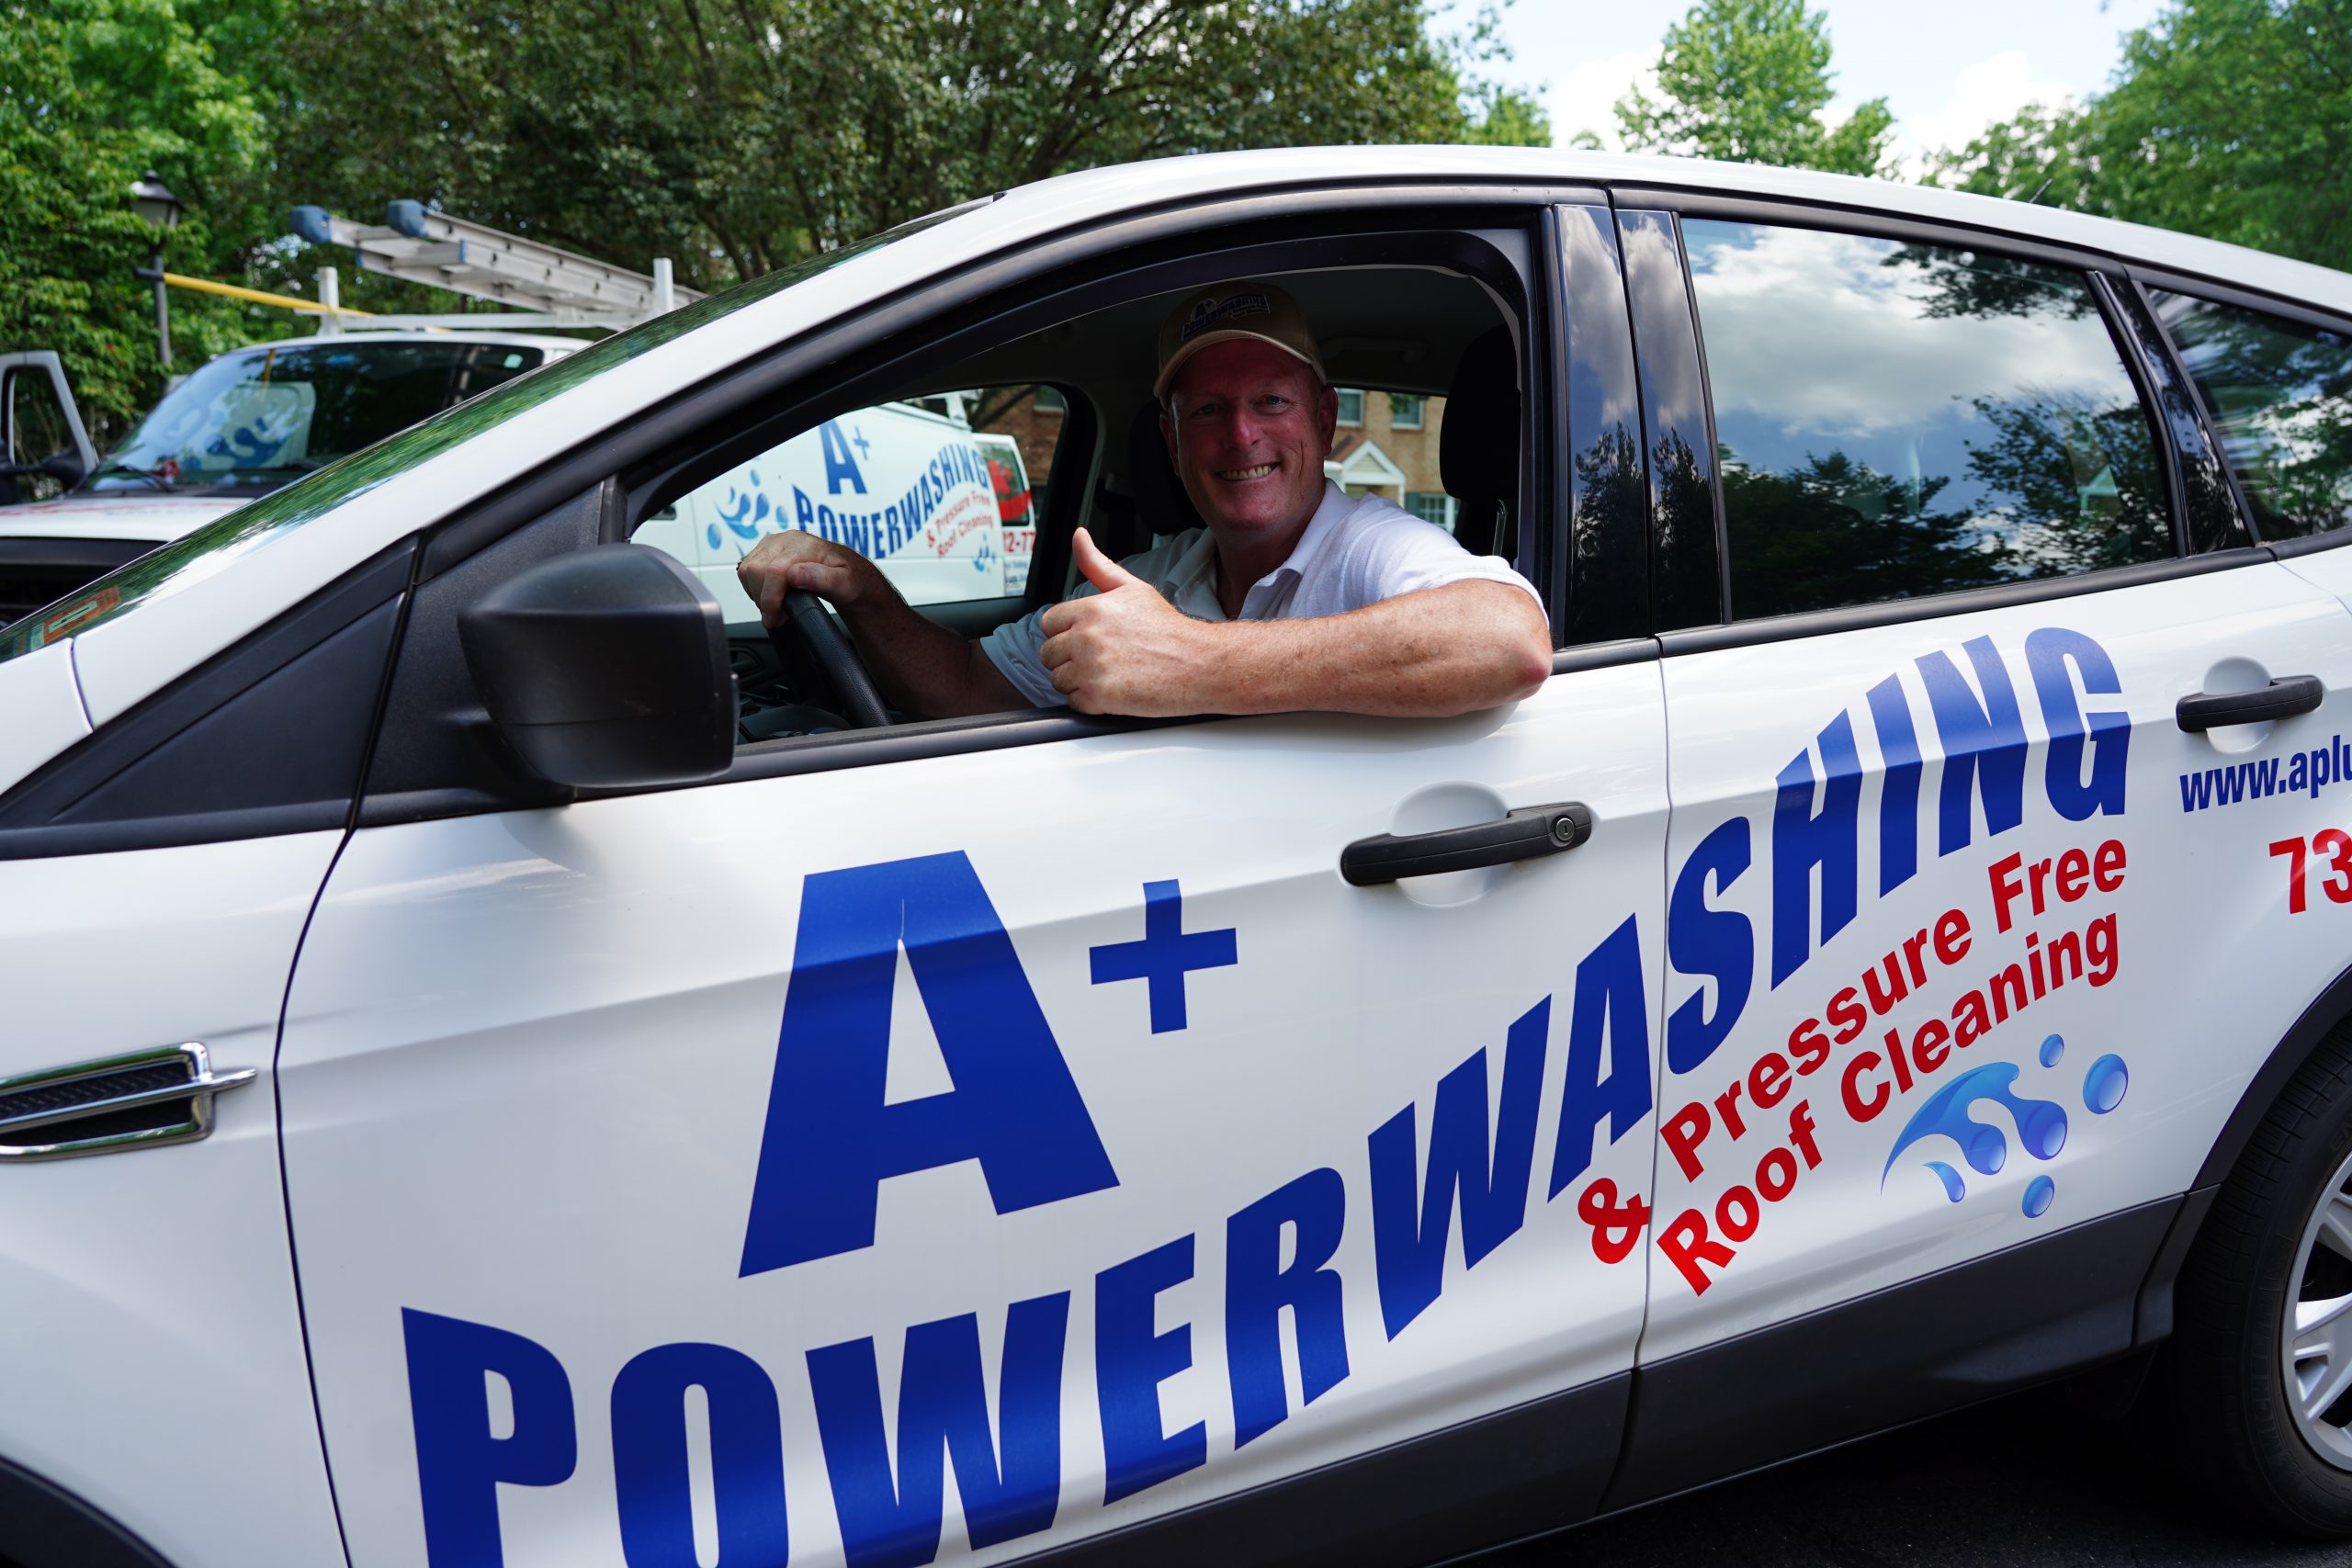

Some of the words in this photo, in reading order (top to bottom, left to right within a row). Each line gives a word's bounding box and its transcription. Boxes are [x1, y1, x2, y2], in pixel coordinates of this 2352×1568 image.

[793, 443, 989, 558] POWERWASHING
[820, 418, 870, 494] A+
[1577, 1178, 1650, 1265] &
[1659, 908, 1973, 1183] Pressure
[1987, 840, 2127, 935] Free
[2268, 828, 2352, 914] 73
[401, 627, 2131, 1568] POWERWASHING
[740, 851, 1238, 1278] A+
[1657, 1100, 1823, 1297] Roof
[1840, 913, 2120, 1123] Cleaning
